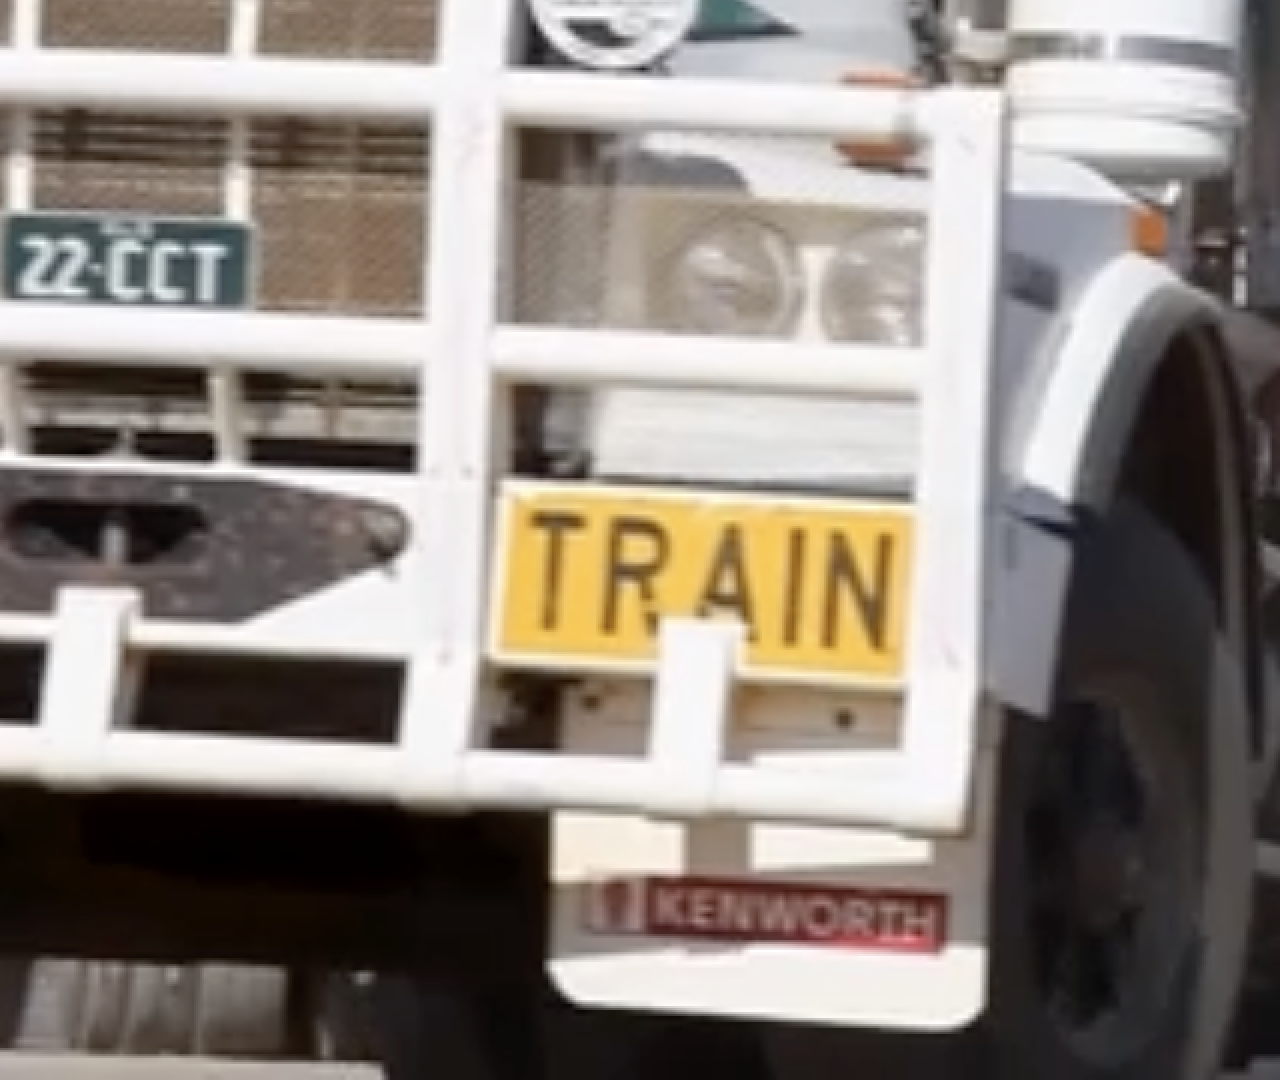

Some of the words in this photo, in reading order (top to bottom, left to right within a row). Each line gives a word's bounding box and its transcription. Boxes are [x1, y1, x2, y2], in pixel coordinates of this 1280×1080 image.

[15, 233, 231, 303] 22-CCT
[528, 511, 894, 652] TRAIN
[654, 884, 936, 947] KENWORTH
